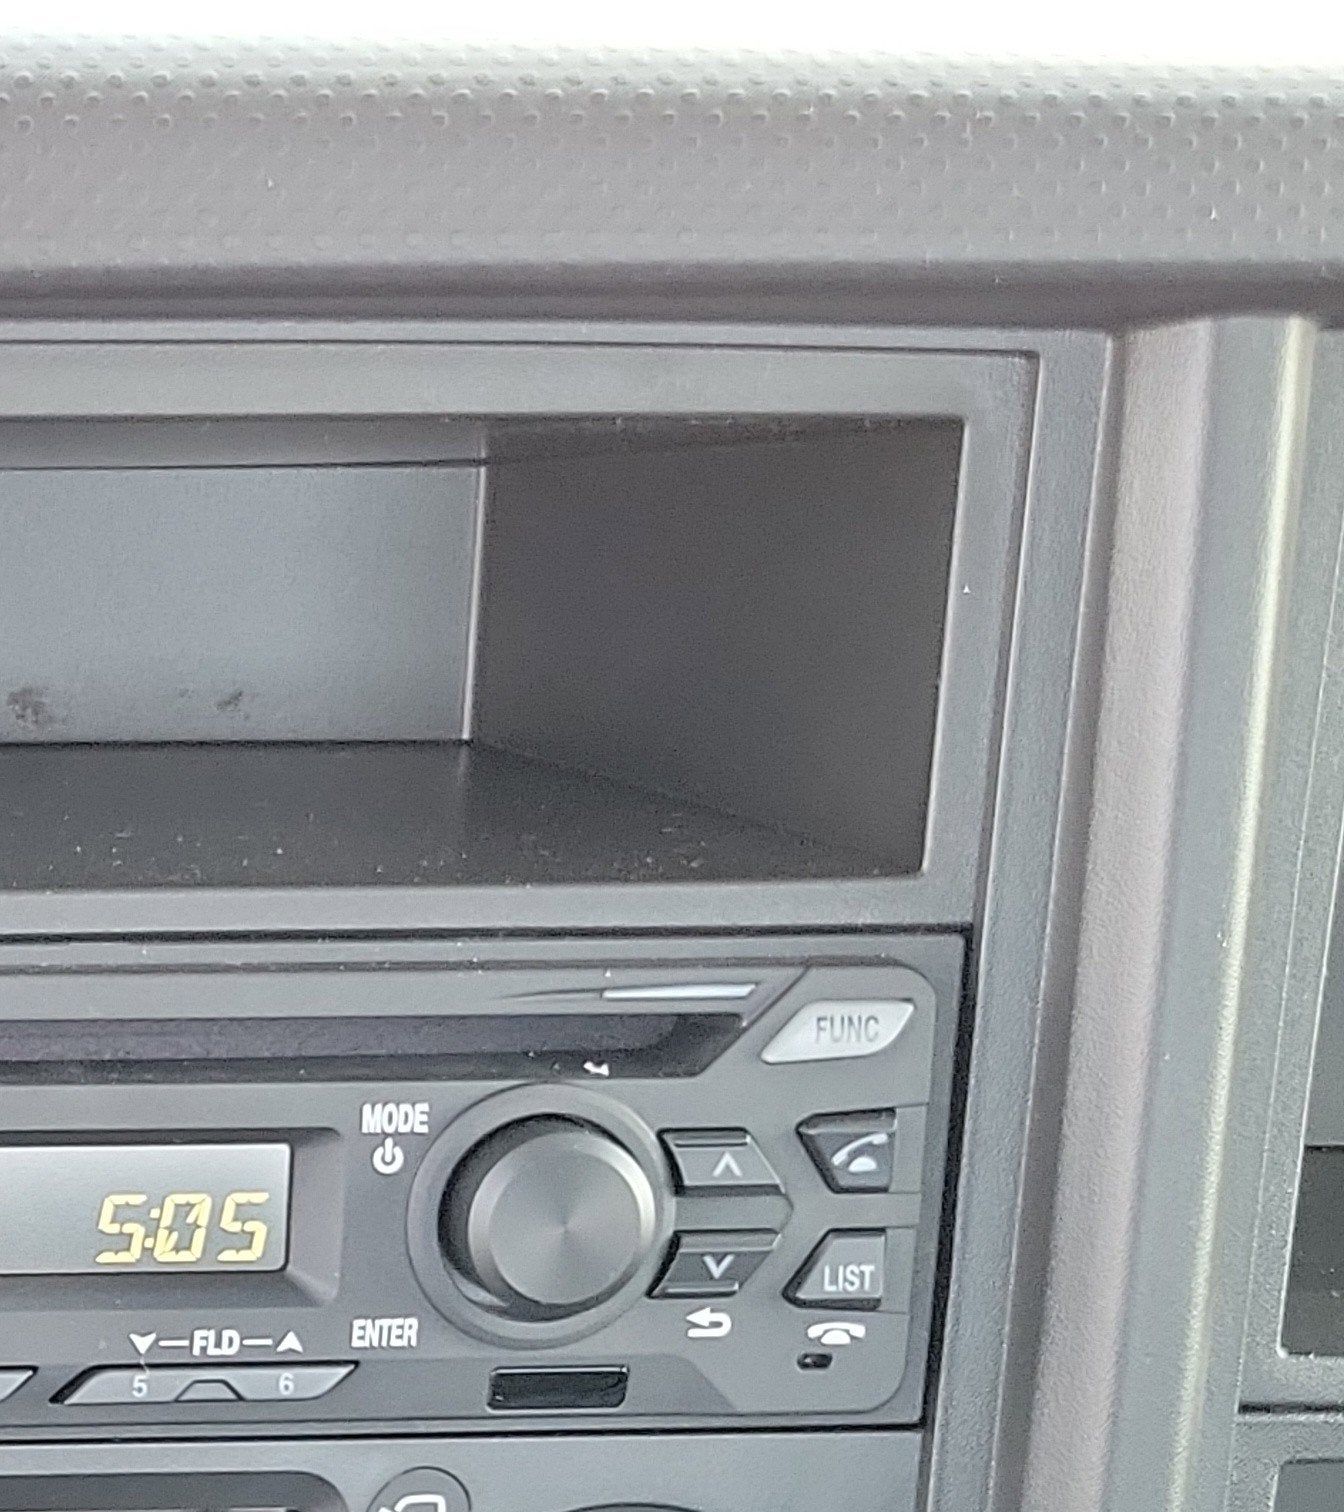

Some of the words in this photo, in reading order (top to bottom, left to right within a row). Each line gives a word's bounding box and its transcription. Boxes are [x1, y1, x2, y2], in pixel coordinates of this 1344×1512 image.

[815, 1014, 880, 1044] FUNC
[361, 1102, 429, 1134] MODE
[95, 1192, 269, 1263] 5:05
[823, 1264, 875, 1293] LIST
[192, 1329, 242, 1357] FLD
[351, 1317, 419, 1349] ENTER
[131, 1375, 148, 1398] 5
[277, 1373, 295, 1397] 6
